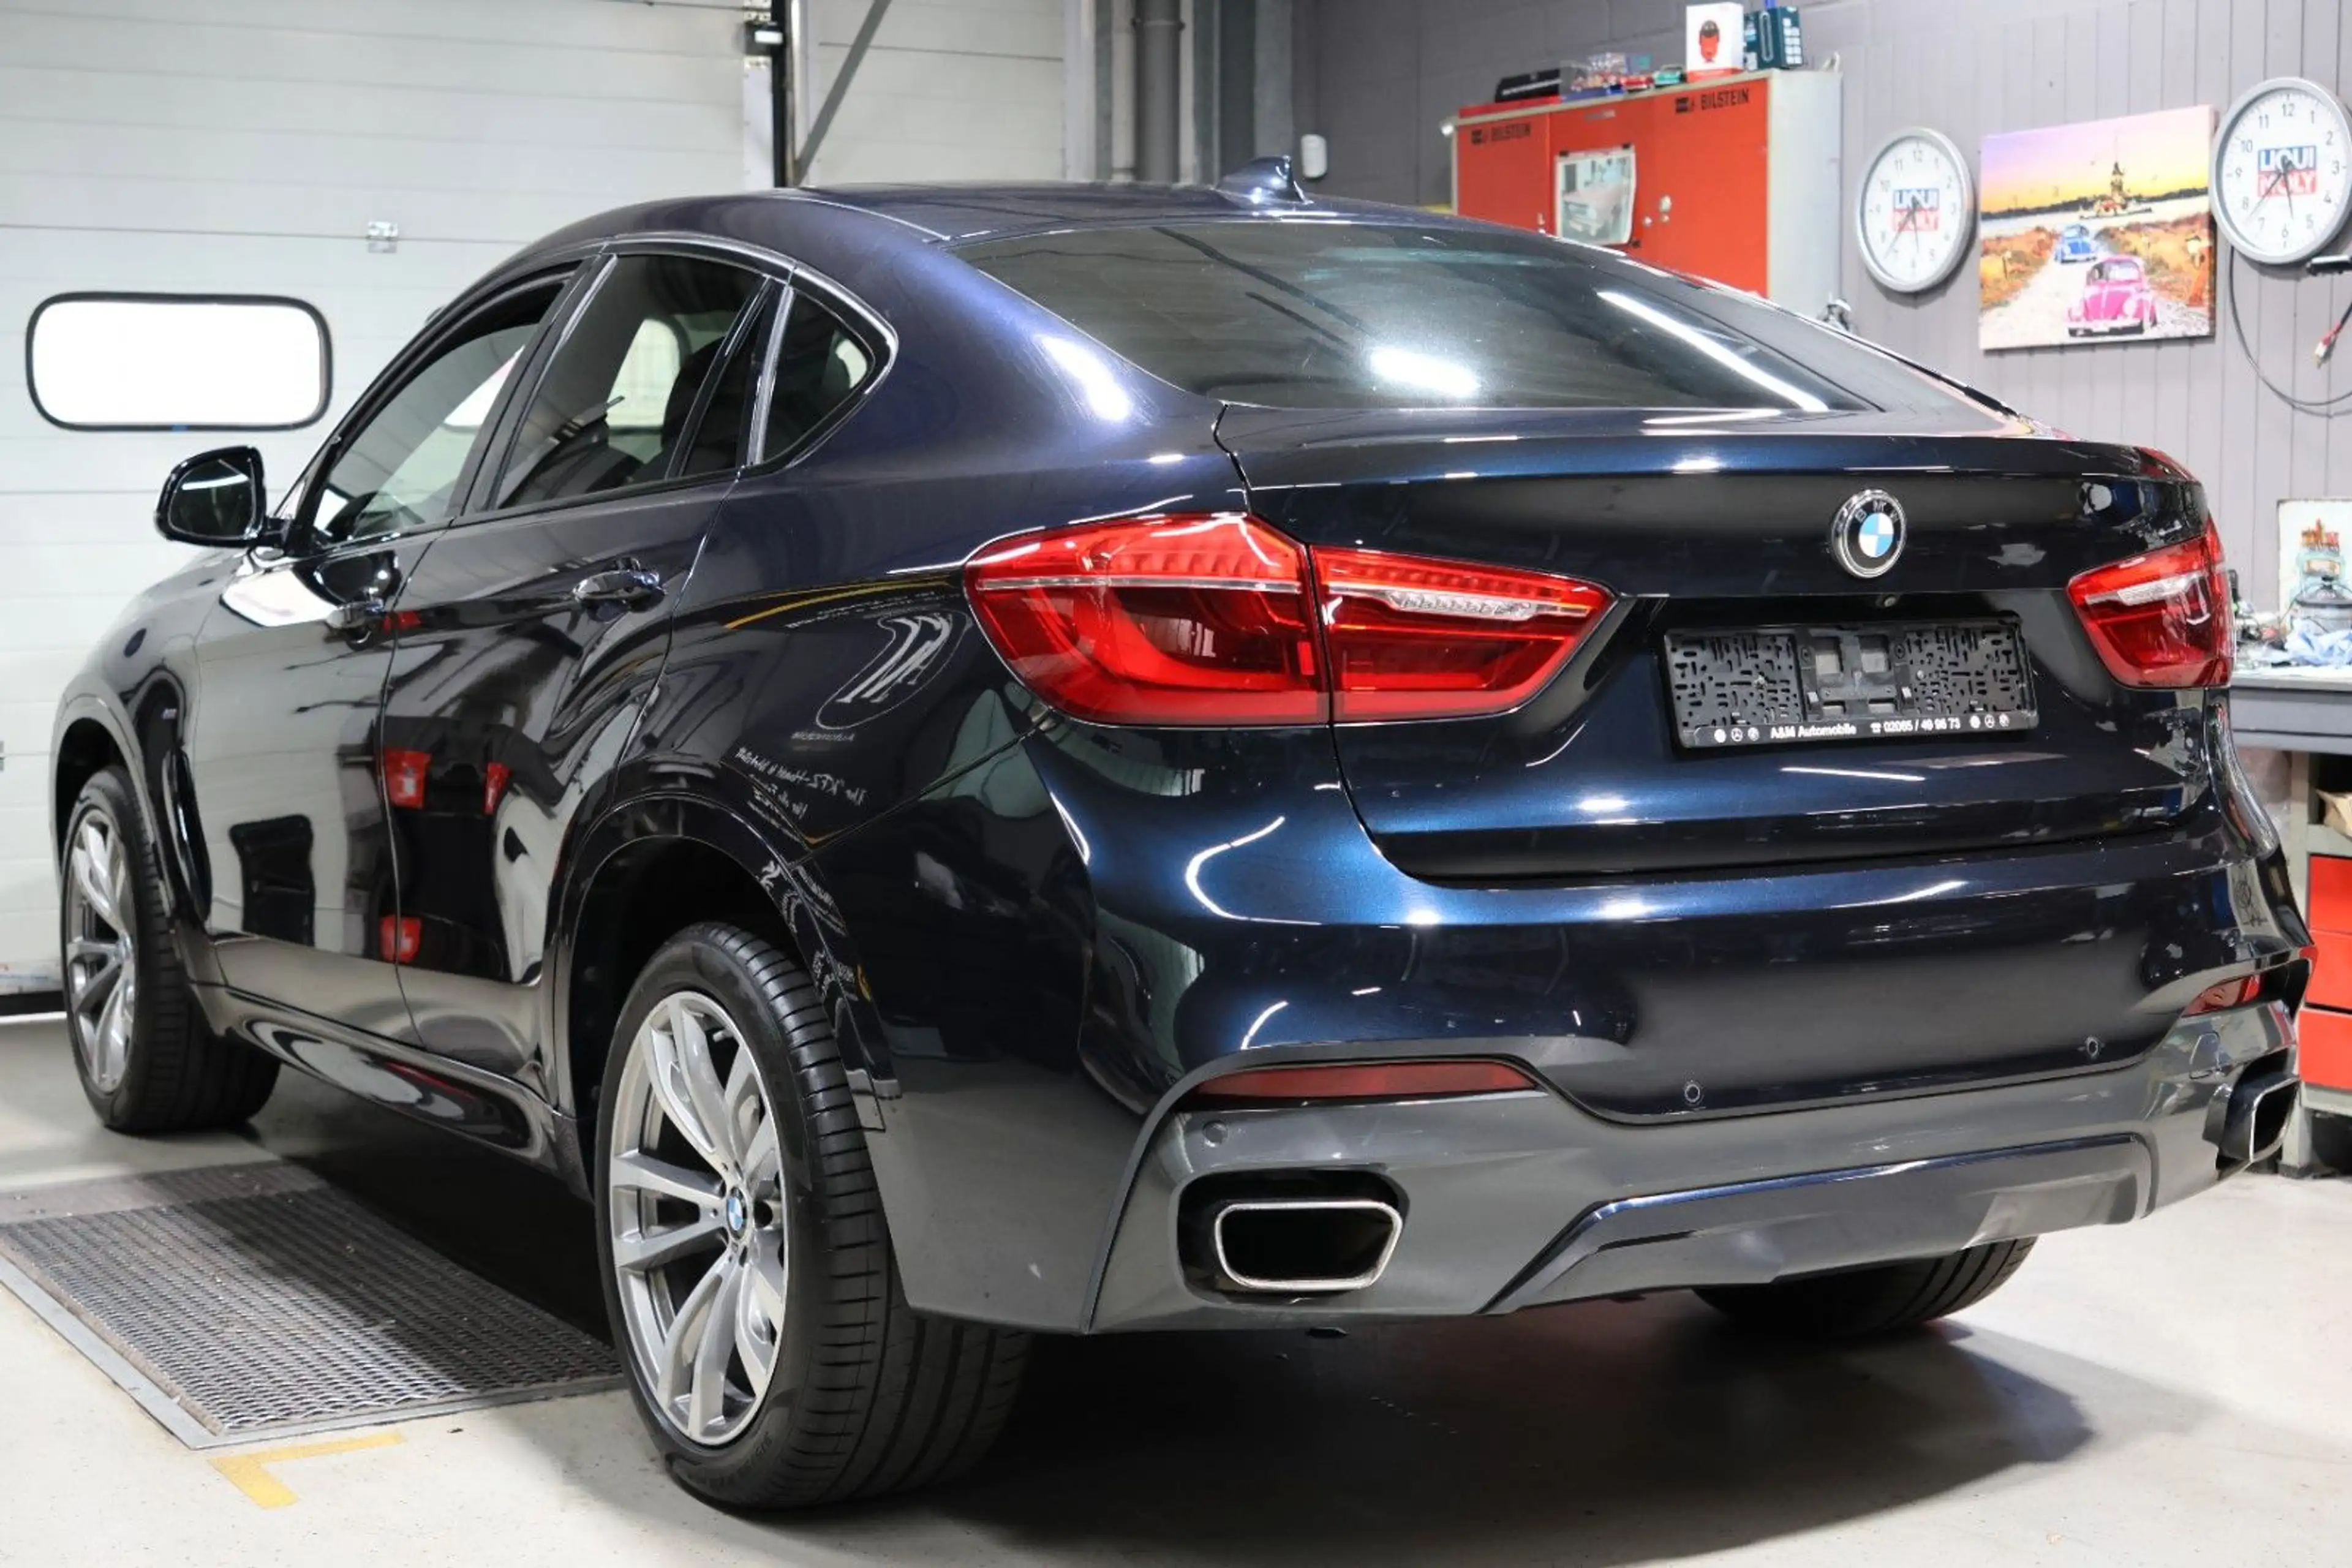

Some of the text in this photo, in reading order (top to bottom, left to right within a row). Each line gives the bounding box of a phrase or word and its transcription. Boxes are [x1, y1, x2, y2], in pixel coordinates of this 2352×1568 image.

[1700, 88, 1750, 110] BILSTEIN
[2282, 103, 2295, 117] 12
[2310, 110, 2315, 124] 1
[2258, 114, 2270, 129] 11
[2326, 130, 2334, 146] 2
[2241, 139, 2253, 153] 10
[2331, 160, 2340, 175] 3
[2305, 214, 2314, 229] 5
[1797, 722, 1857, 738] Automobile
